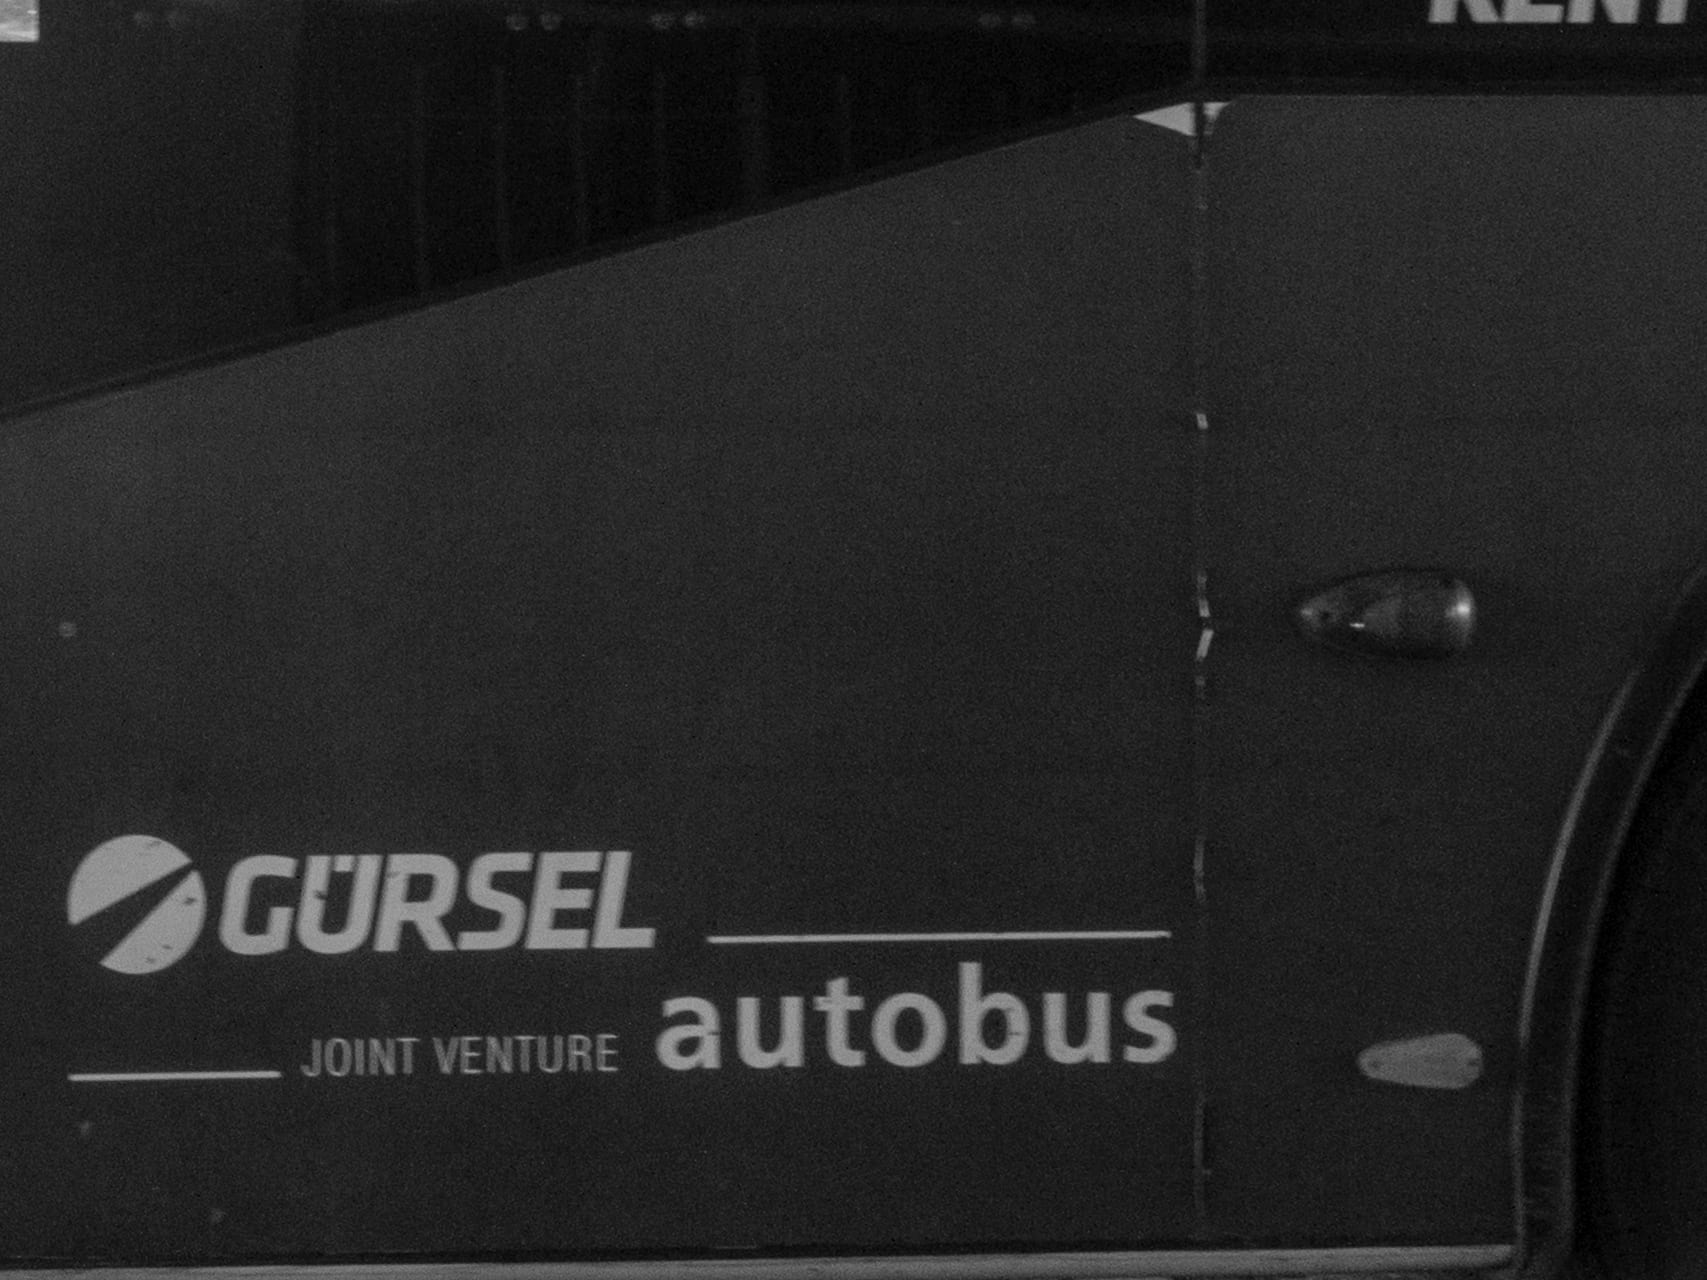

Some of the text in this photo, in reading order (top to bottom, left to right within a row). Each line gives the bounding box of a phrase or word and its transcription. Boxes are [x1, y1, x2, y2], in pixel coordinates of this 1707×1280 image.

[219, 850, 656, 955] GÜRSEL
[301, 1034, 619, 1078] JOINT VENTURE
[656, 961, 1175, 1071] autobus
